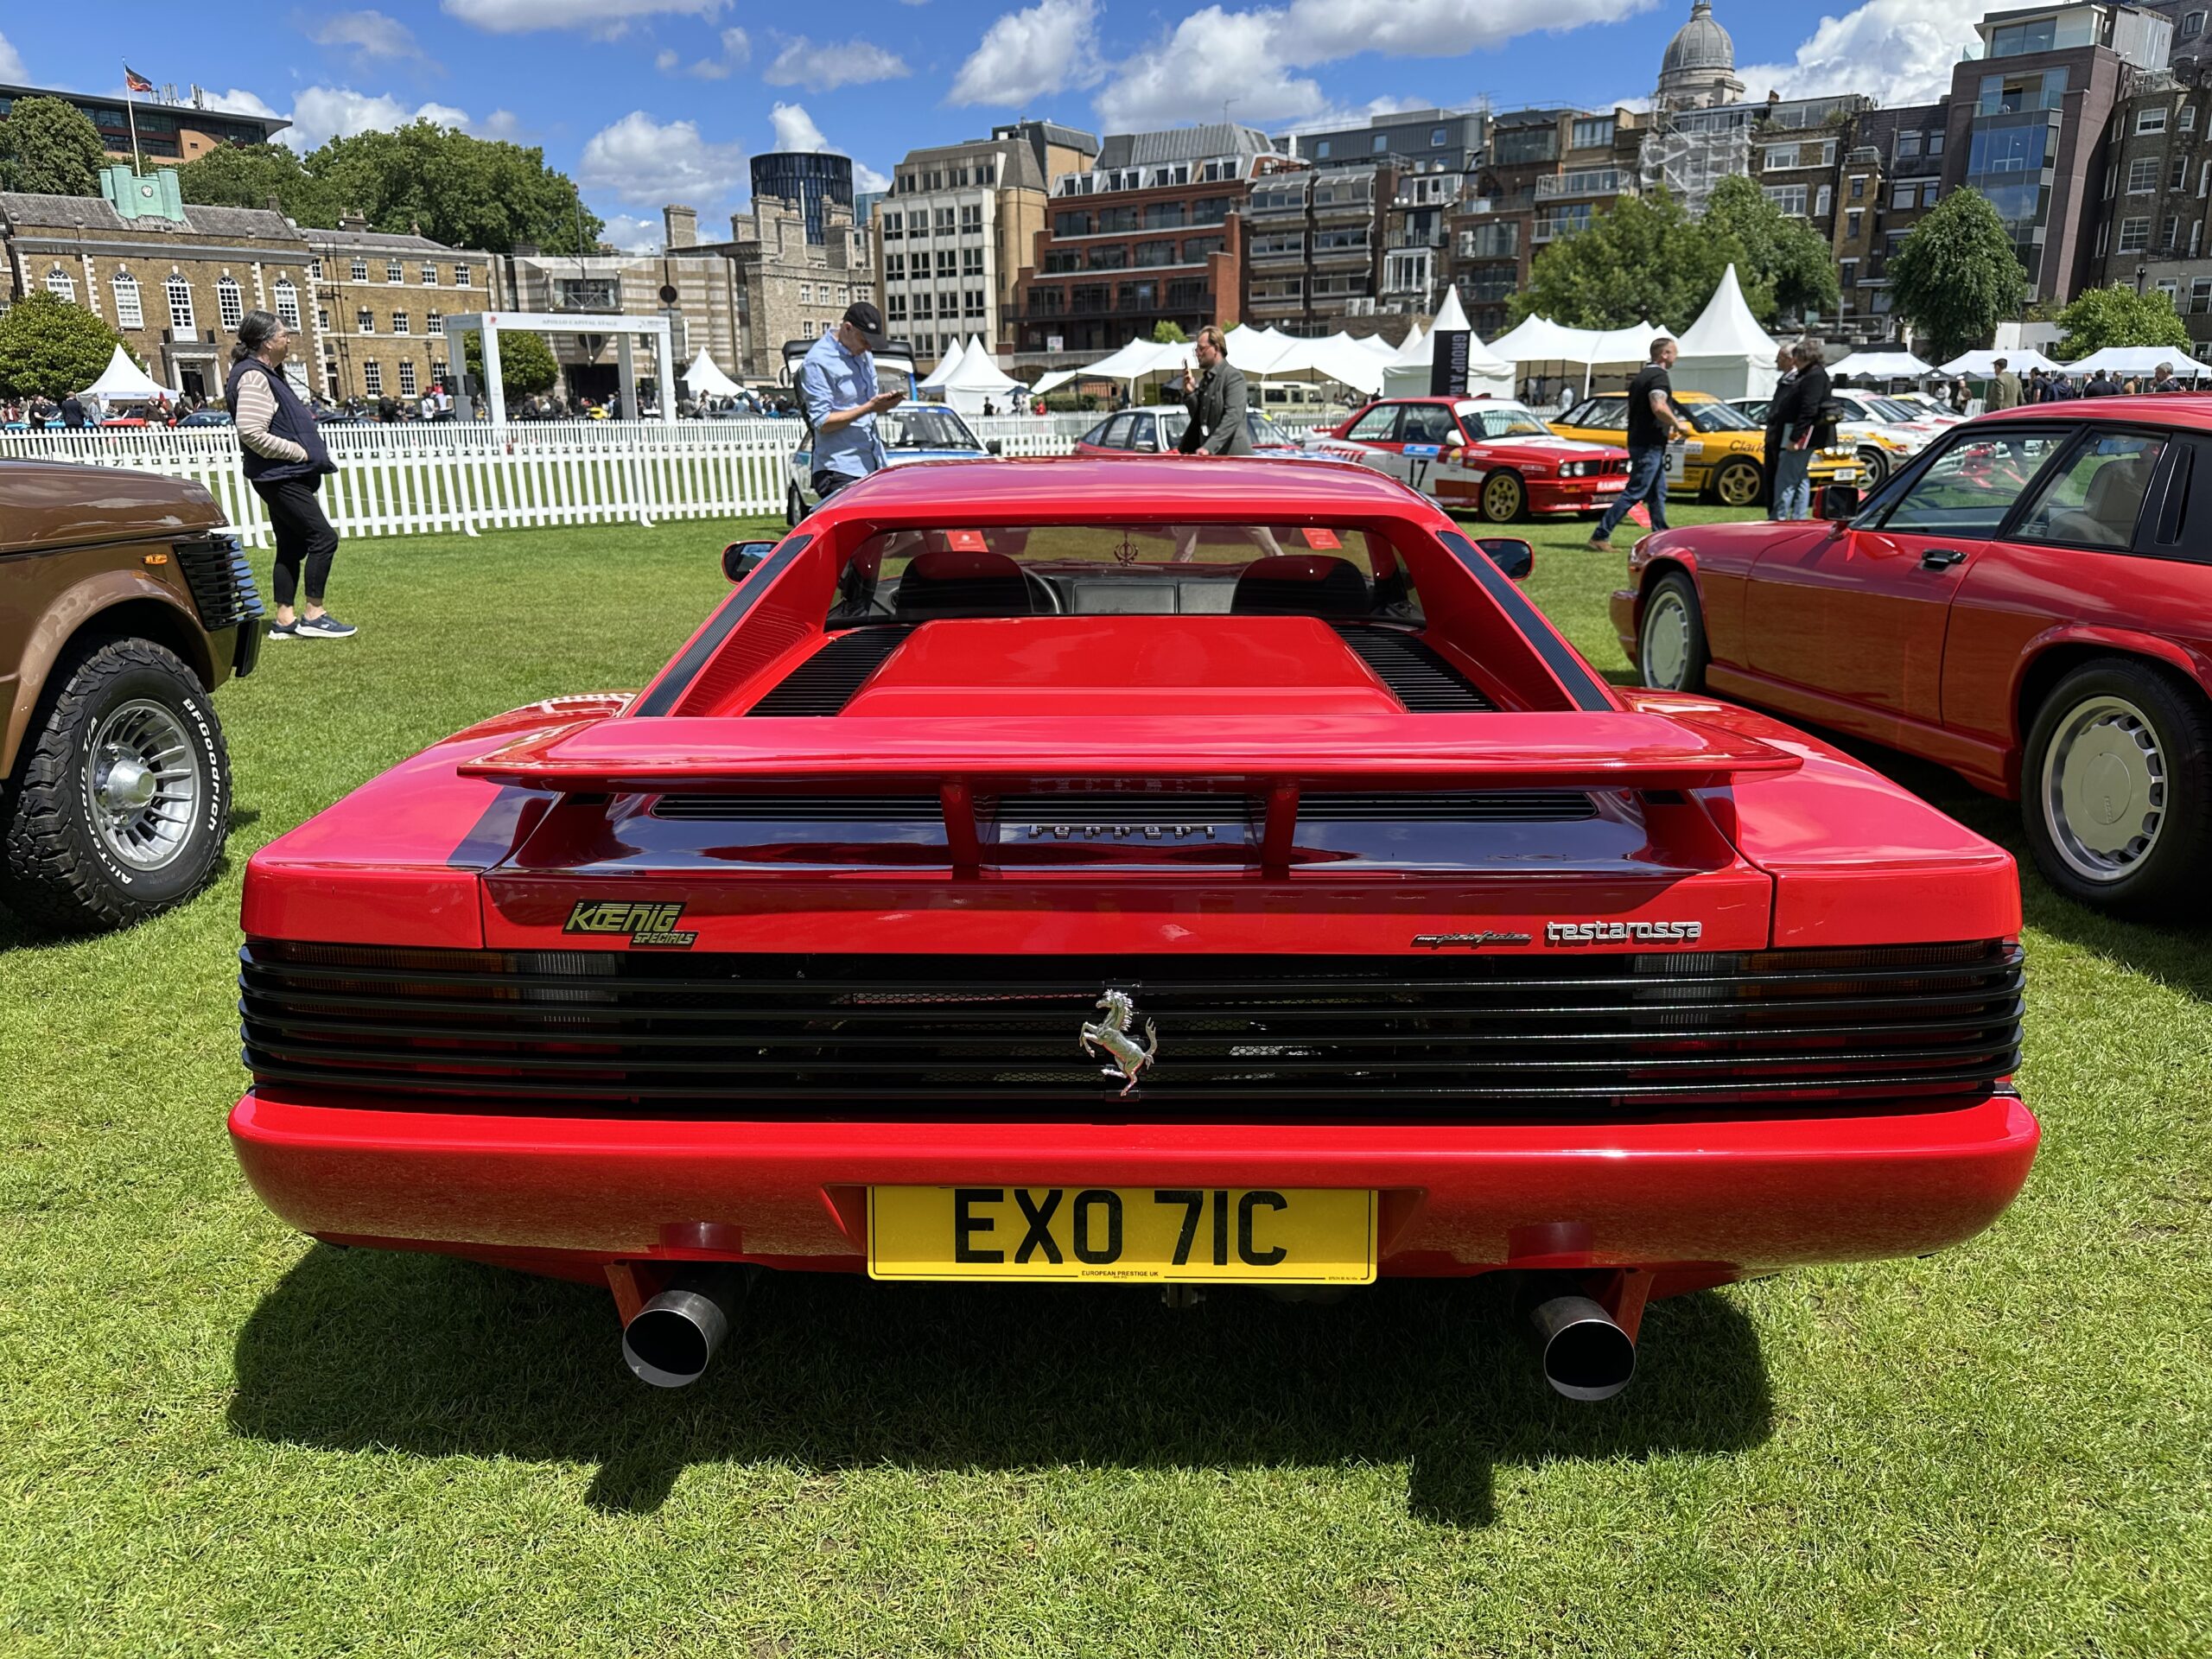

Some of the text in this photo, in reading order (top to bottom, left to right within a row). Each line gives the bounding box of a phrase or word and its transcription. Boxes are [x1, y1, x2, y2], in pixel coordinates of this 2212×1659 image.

[1451, 334, 1467, 373] GROUP
[1450, 375, 1465, 384] A
[1409, 459, 1429, 486] 17
[82, 716, 98, 753] T/A
[182, 698, 220, 831] BFGoodrich
[632, 931, 696, 944] SPECIALS
[1547, 921, 1702, 940] testarossa
[954, 1189, 1122, 1265] EXO
